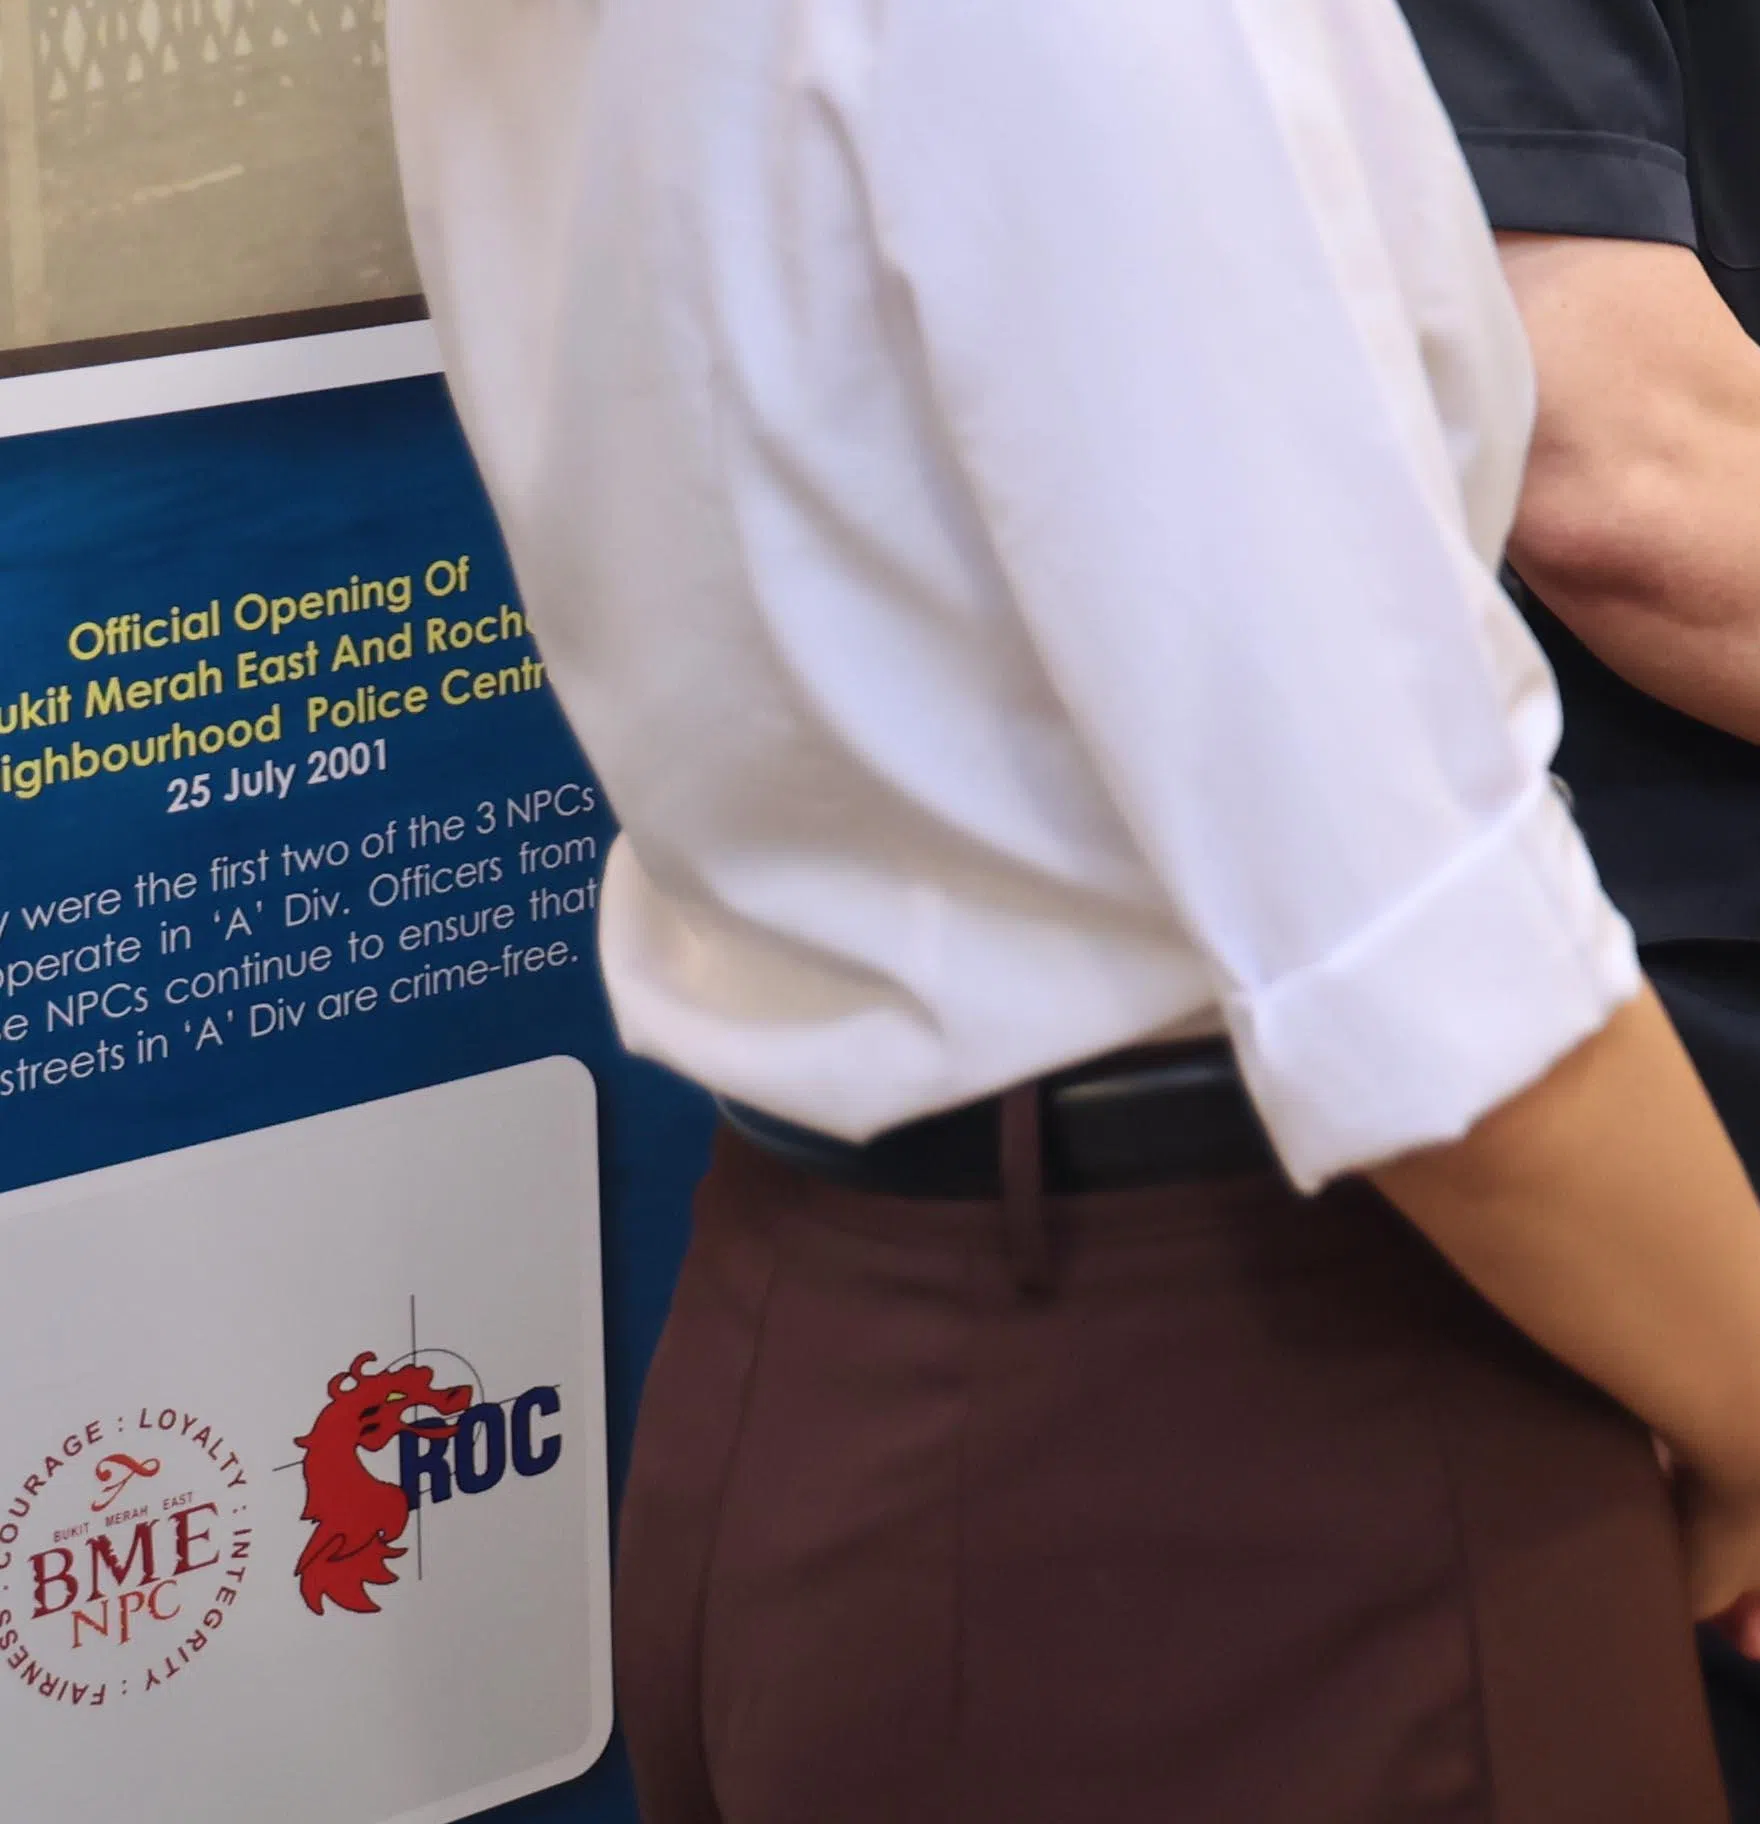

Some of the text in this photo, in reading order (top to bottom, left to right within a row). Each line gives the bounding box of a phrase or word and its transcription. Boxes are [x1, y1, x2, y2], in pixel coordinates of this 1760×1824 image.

[68, 555, 470, 661] Official Opening Of
[0, 604, 532, 735] ukit Merah East And Roch
[0, 703, 282, 800] ighbourhood
[307, 685, 429, 733] Police
[166, 738, 387, 814] 25 July 2001
[0, 933, 142, 997] perate
[160, 920, 192, 955] in
[285, 887, 350, 927] Div.
[368, 856, 503, 907] Officers
[519, 835, 596, 874] from
[22, 888, 122, 931] were
[135, 872, 198, 908] the
[210, 849, 269, 892] first
[281, 840, 350, 877] two
[361, 820, 397, 859] of
[408, 814, 465, 849] the
[476, 800, 497, 835] 3
[507, 783, 595, 827] NPCs
[47, 982, 149, 1032] NPCs
[165, 945, 332, 1005] continue
[348, 930, 384, 963] to
[399, 903, 515, 951] ensure
[529, 877, 598, 921] that
[0, 1039, 125, 1096] streets
[137, 1030, 168, 1064] in
[250, 998, 306, 1038] Div
[318, 985, 379, 1020] are
[390, 940, 578, 1003] crime-free.
[138, 1407, 248, 1489] LOYALTY
[398, 1385, 563, 1512] ROC
[27, 1502, 220, 1620] BME
[53, 1491, 194, 1543] BUKIT MERAH EAST
[71, 1579, 181, 1649] NPC
[144, 1528, 253, 1691] INTEGRITY
